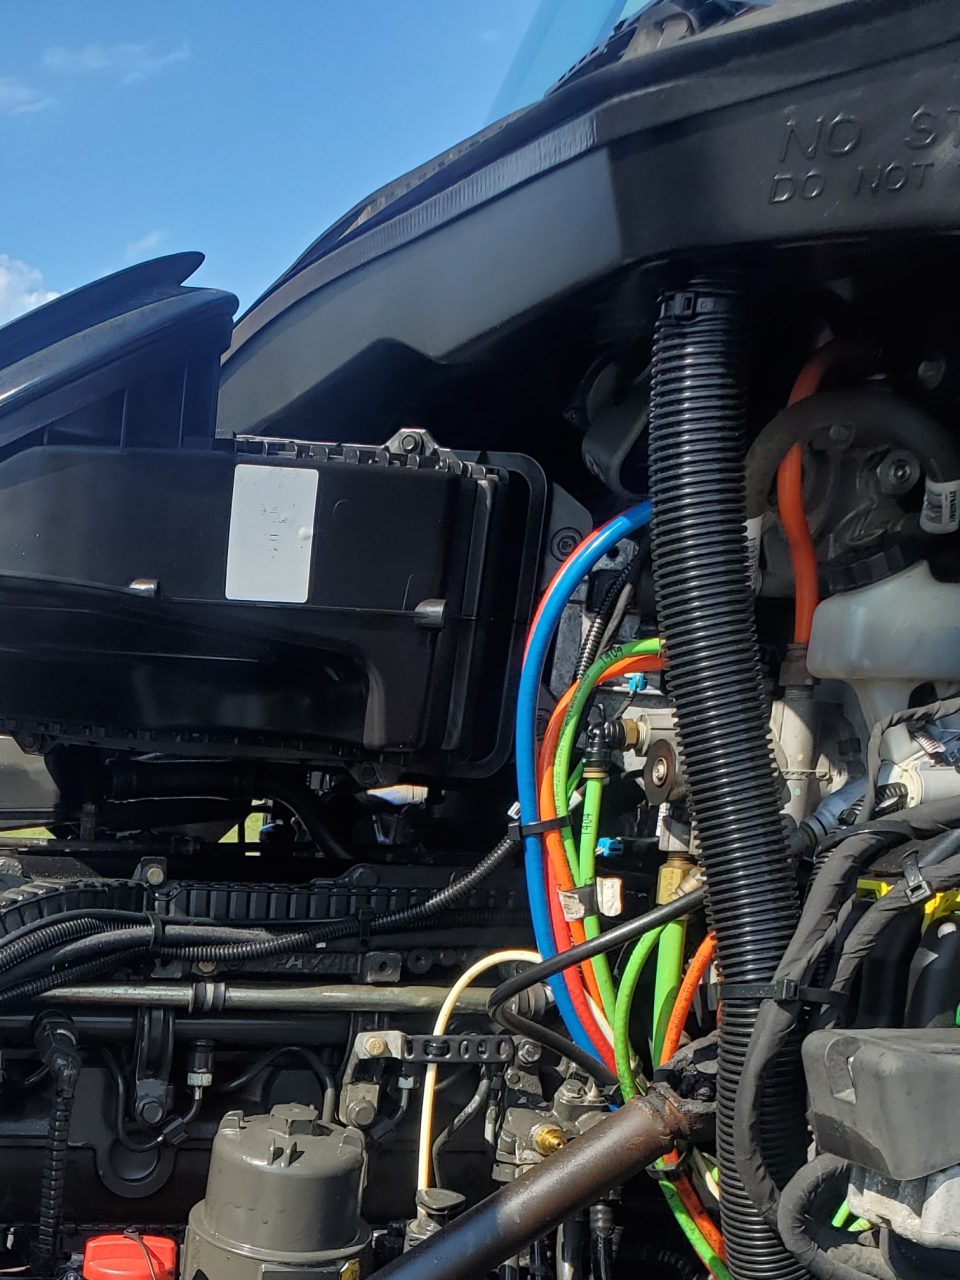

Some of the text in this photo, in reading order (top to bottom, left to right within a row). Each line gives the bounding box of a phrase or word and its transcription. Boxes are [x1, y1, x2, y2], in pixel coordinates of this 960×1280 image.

[778, 112, 862, 163] NO
[768, 160, 935, 204] DO NOT
